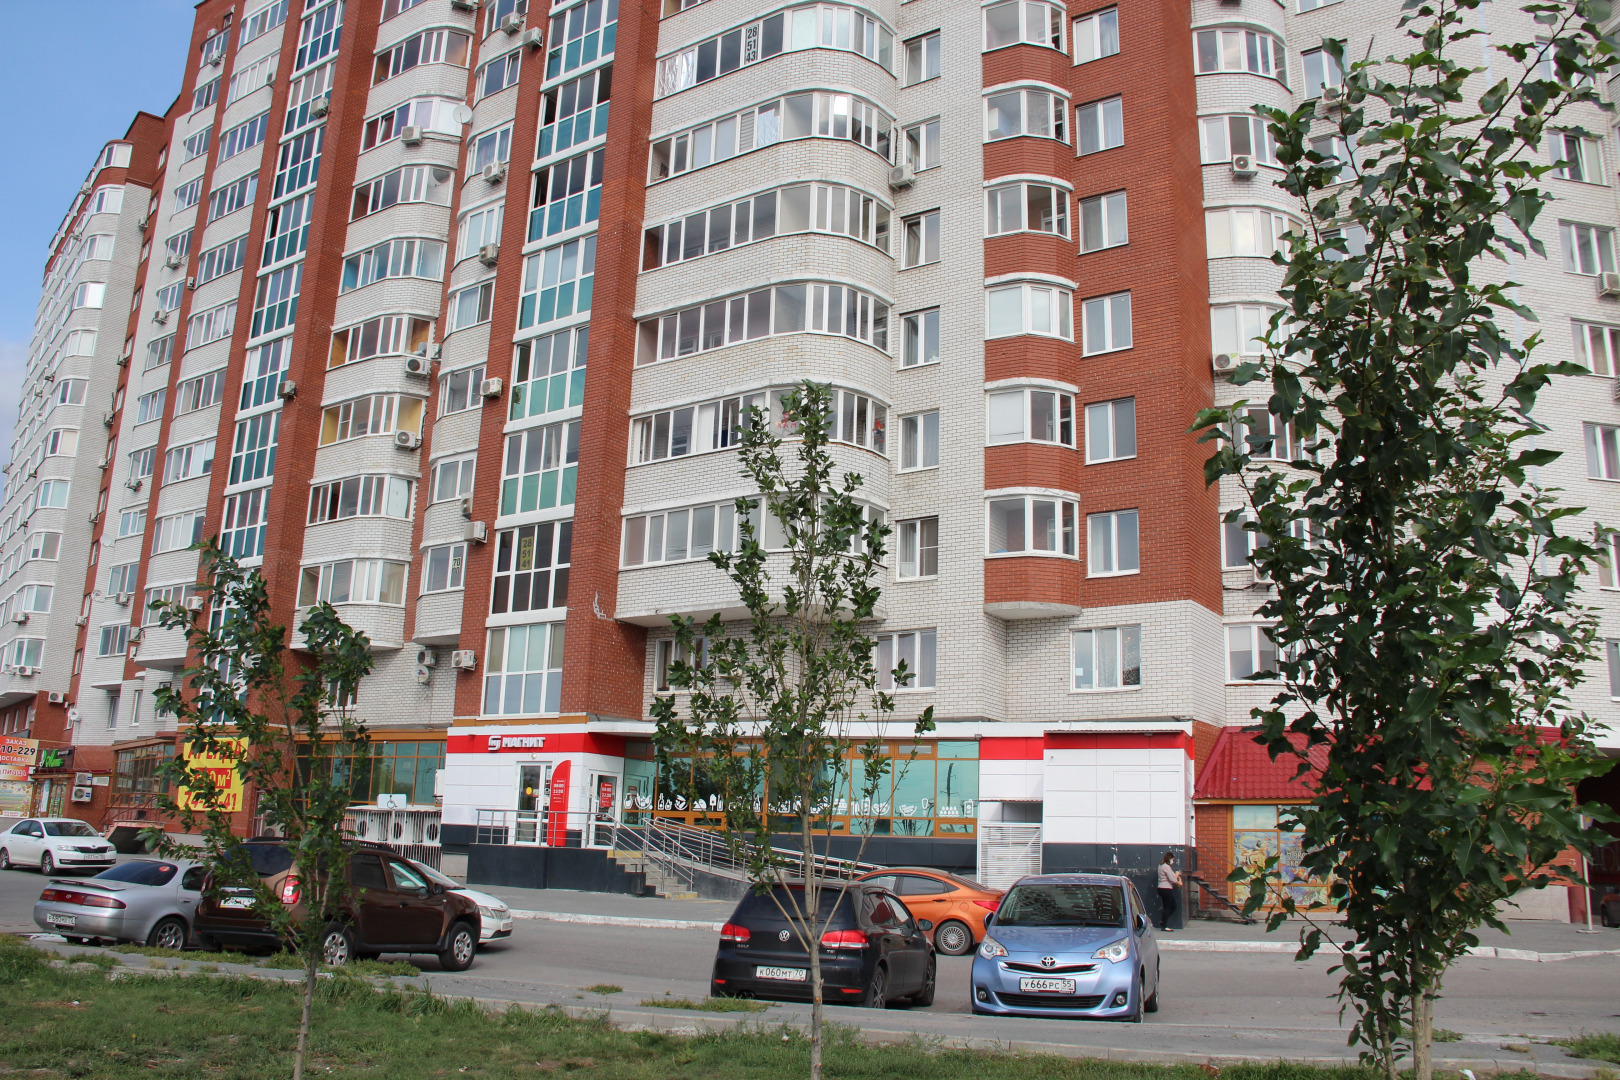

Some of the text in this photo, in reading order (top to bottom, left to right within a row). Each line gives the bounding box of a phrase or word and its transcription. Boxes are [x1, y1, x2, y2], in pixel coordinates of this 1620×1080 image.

[747, 26, 758, 39] 28
[747, 39, 756, 52] 51
[523, 538, 532, 548] 28
[522, 549, 531, 558] 51
[5, 738, 27, 746] ЗАКАЗ
[502, 736, 546, 748] МАГНИТ
